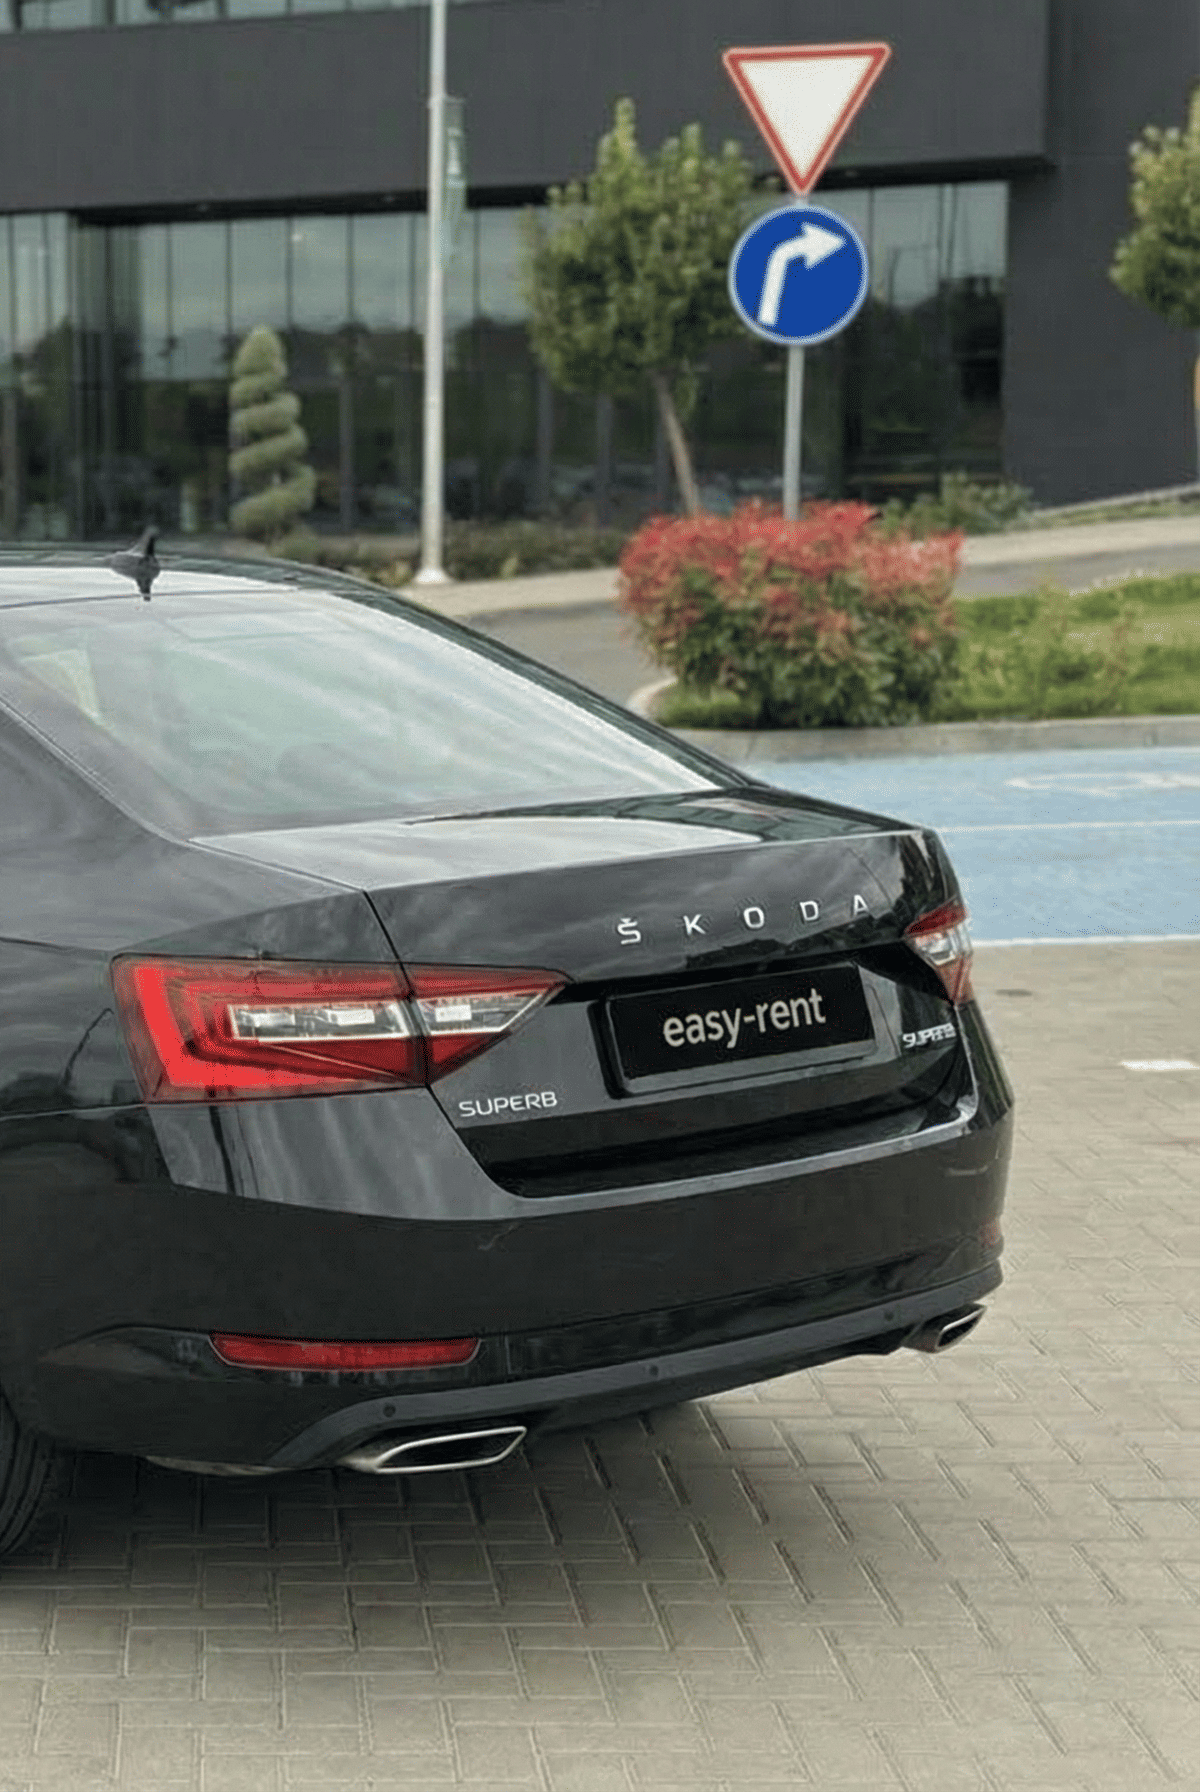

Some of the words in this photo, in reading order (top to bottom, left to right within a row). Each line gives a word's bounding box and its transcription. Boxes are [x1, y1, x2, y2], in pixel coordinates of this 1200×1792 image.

[617, 894, 870, 945] ŠKODA
[663, 987, 827, 1049] easy-rent
[458, 1091, 558, 1117] SUPERB
